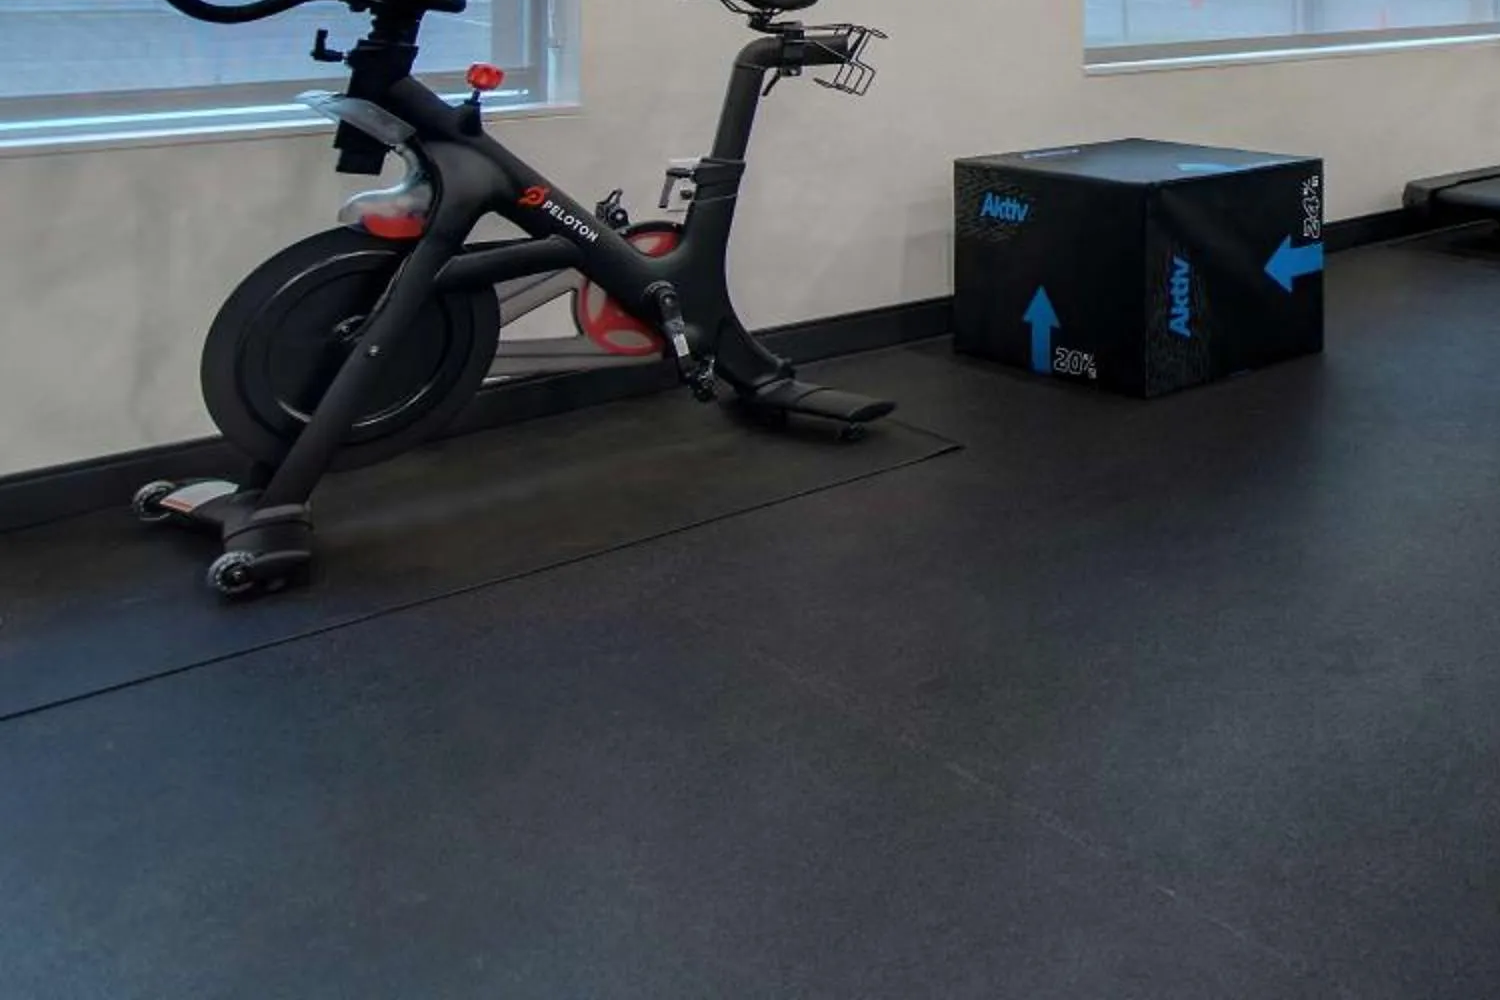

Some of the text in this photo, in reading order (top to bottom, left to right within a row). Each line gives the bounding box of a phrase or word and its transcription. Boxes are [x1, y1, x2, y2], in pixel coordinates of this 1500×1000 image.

[541, 200, 599, 242] PELOTON
[980, 191, 1029, 221] Aktiv
[1169, 256, 1192, 338] Aktiv
